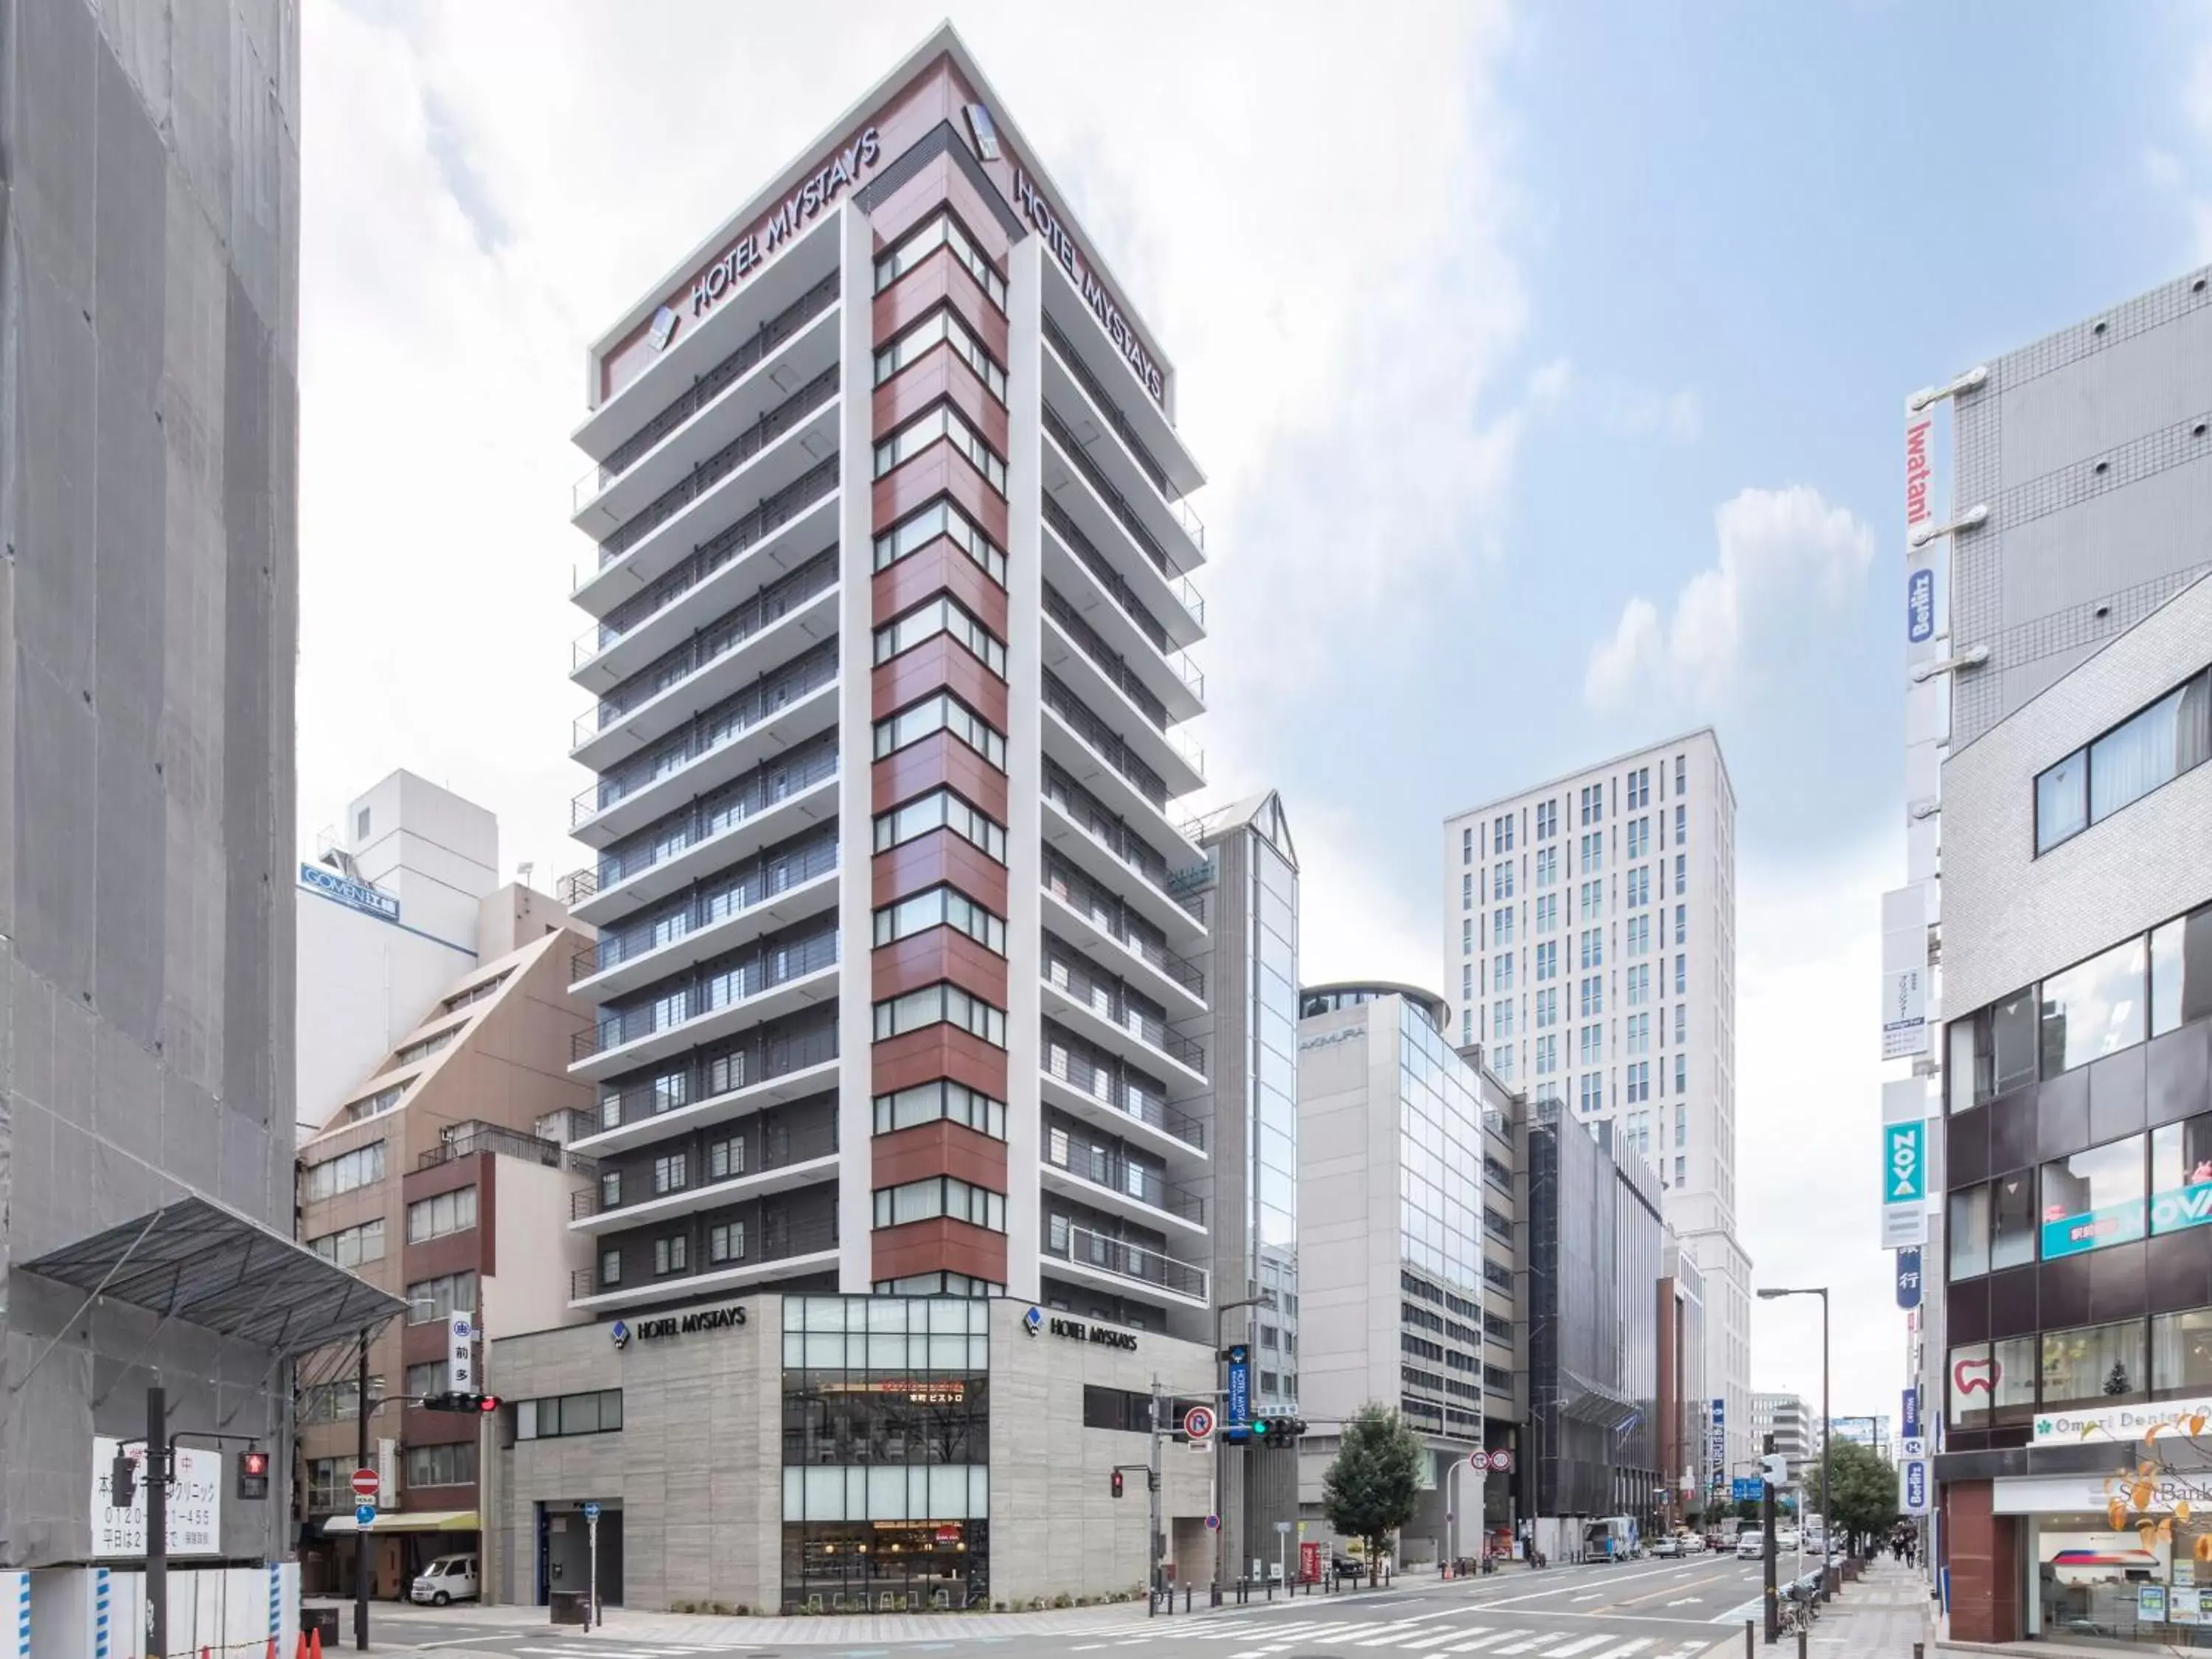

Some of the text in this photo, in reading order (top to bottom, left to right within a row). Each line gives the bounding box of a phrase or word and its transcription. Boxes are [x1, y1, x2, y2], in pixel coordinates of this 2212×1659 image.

[690, 127, 880, 317] HOTEL MYSTAYS
[1013, 167, 1163, 400] HOTEL MYSTAYS
[1907, 420, 1932, 525] Iwatani
[1911, 572, 1930, 639] Berlitz
[1893, 1130, 1916, 1196] NOVA
[637, 1307, 745, 1340] HOTEL MYSTAYS
[1051, 1318, 1137, 1352] HOTEL MYSTAYS
[1237, 1369, 1246, 1394] HOTEL
[1910, 1466, 1922, 1503] Berlitz
